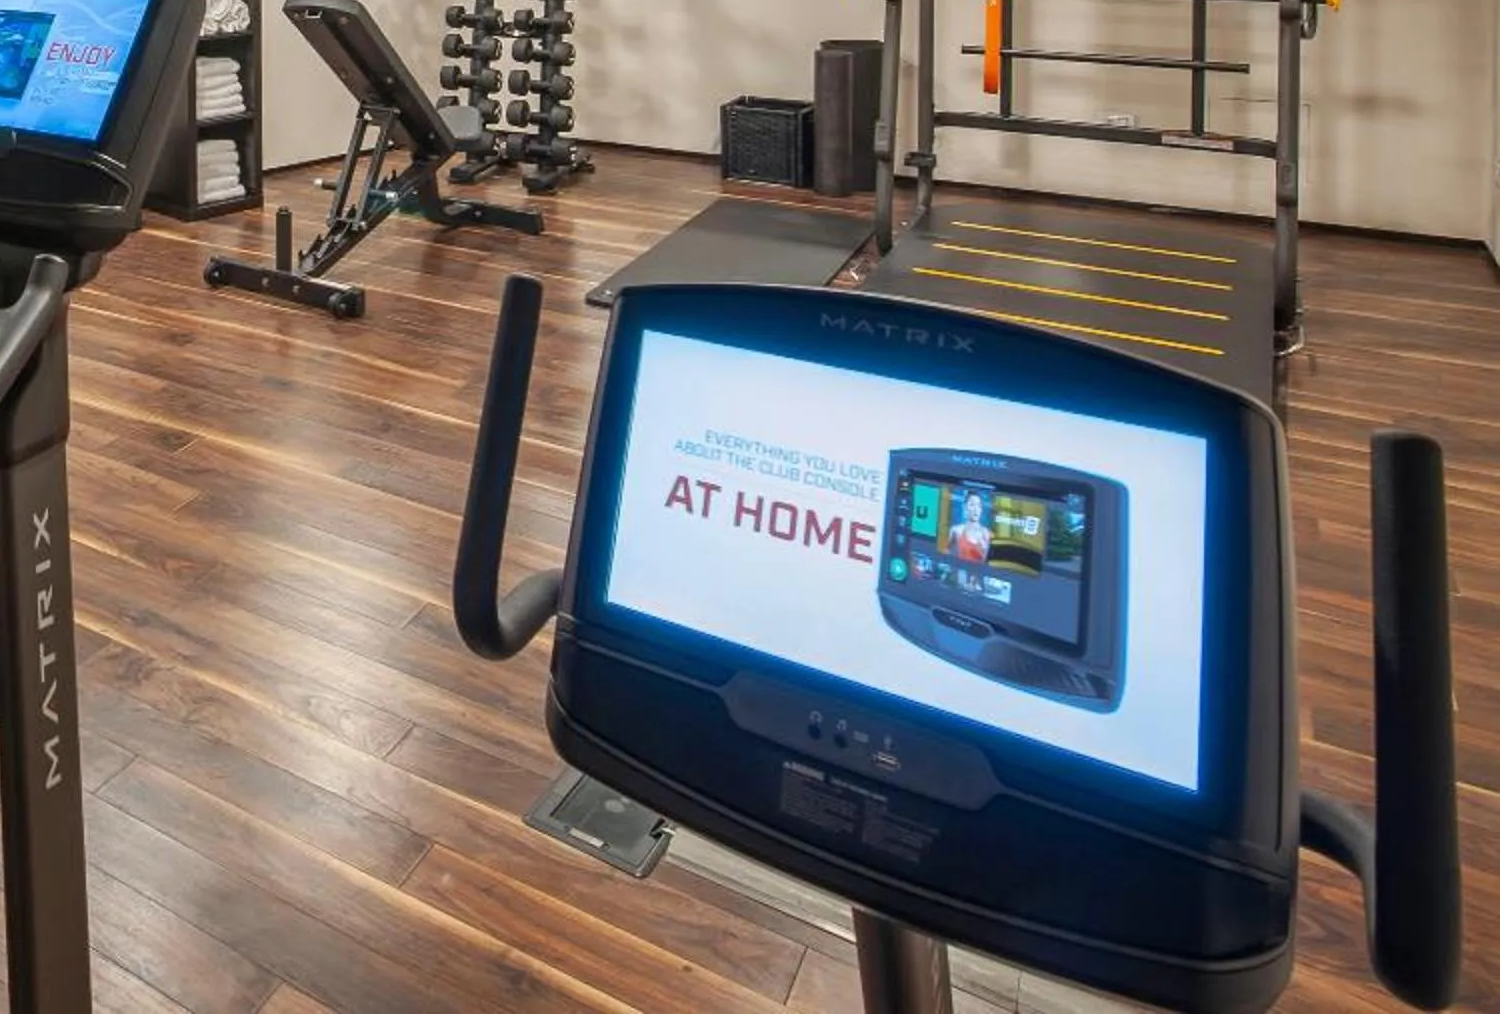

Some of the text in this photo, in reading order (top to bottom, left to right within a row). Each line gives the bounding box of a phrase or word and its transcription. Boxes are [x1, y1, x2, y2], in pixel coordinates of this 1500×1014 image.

[45, 41, 115, 66] ENJOY
[819, 313, 976, 353] MATRIX
[674, 439, 882, 503] ABOUT THE CLUB CONSOLE
[704, 428, 883, 484] EVERYTHING YOU LOVE
[664, 474, 878, 564] AT HOME
[32, 507, 63, 790] MATRIX
